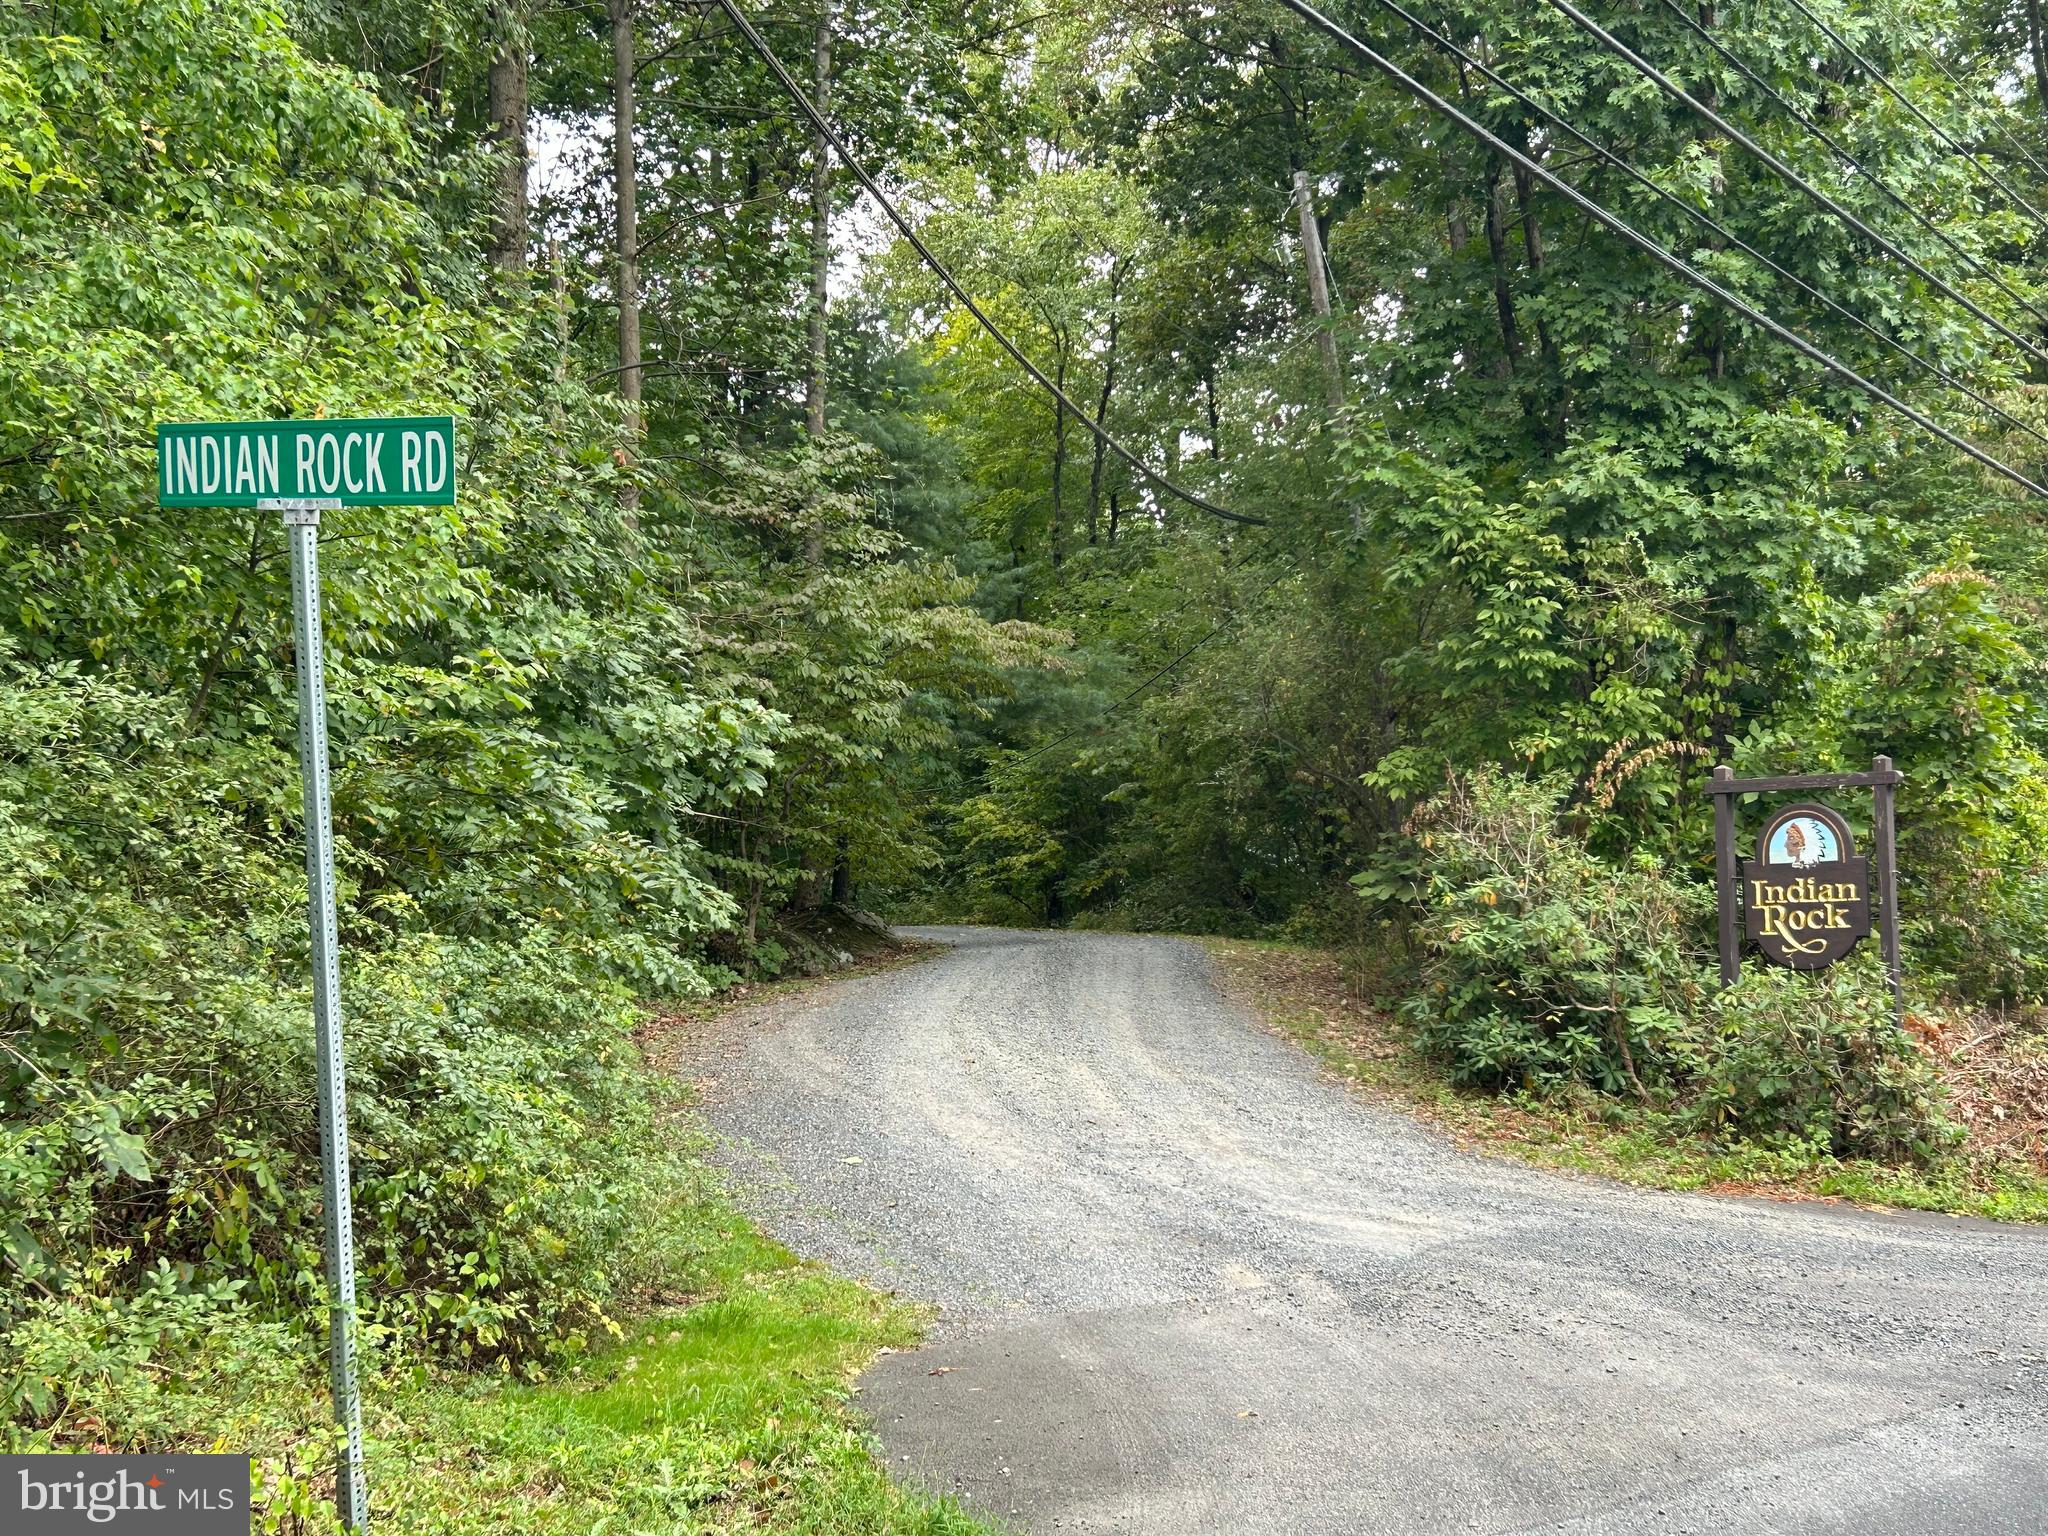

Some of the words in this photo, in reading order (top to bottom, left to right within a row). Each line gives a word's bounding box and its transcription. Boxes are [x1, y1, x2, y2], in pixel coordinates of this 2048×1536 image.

[164, 435, 280, 494] INDIAN
[296, 431, 387, 494] ROCK
[401, 430, 447, 493] RD
[1750, 877, 1861, 909] Indian
[1759, 903, 1852, 954] Rock
